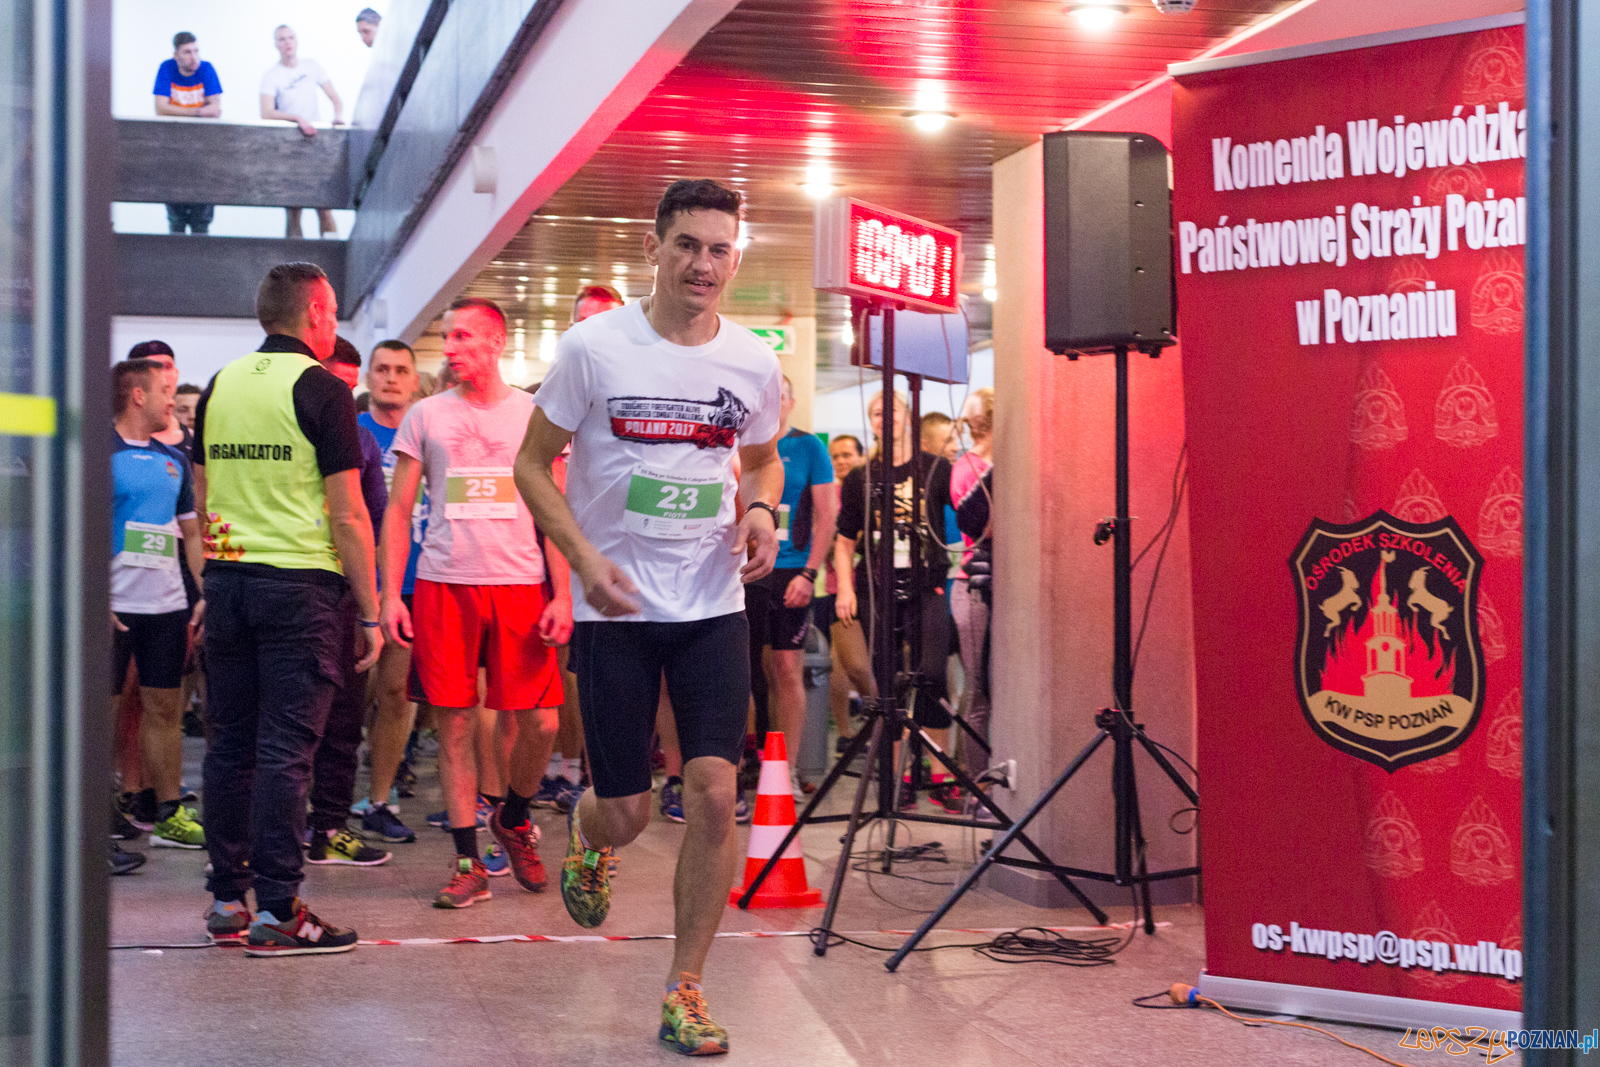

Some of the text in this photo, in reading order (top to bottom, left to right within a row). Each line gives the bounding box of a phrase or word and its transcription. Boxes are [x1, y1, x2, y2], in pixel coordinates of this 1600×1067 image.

[1211, 125, 1344, 191] Komenda
[1179, 205, 1348, 274] Państwowej
[1351, 195, 1441, 259] Straży
[1295, 280, 1457, 345] w Poznaniu
[625, 420, 696, 437] POLAND 2017
[465, 478, 498, 497] 25
[655, 485, 699, 511] 23
[142, 532, 166, 551] 29
[1305, 532, 1467, 594] OŚRODEK SZKOLENIA
[1325, 696, 1454, 730] KW PSP POZNAŃ
